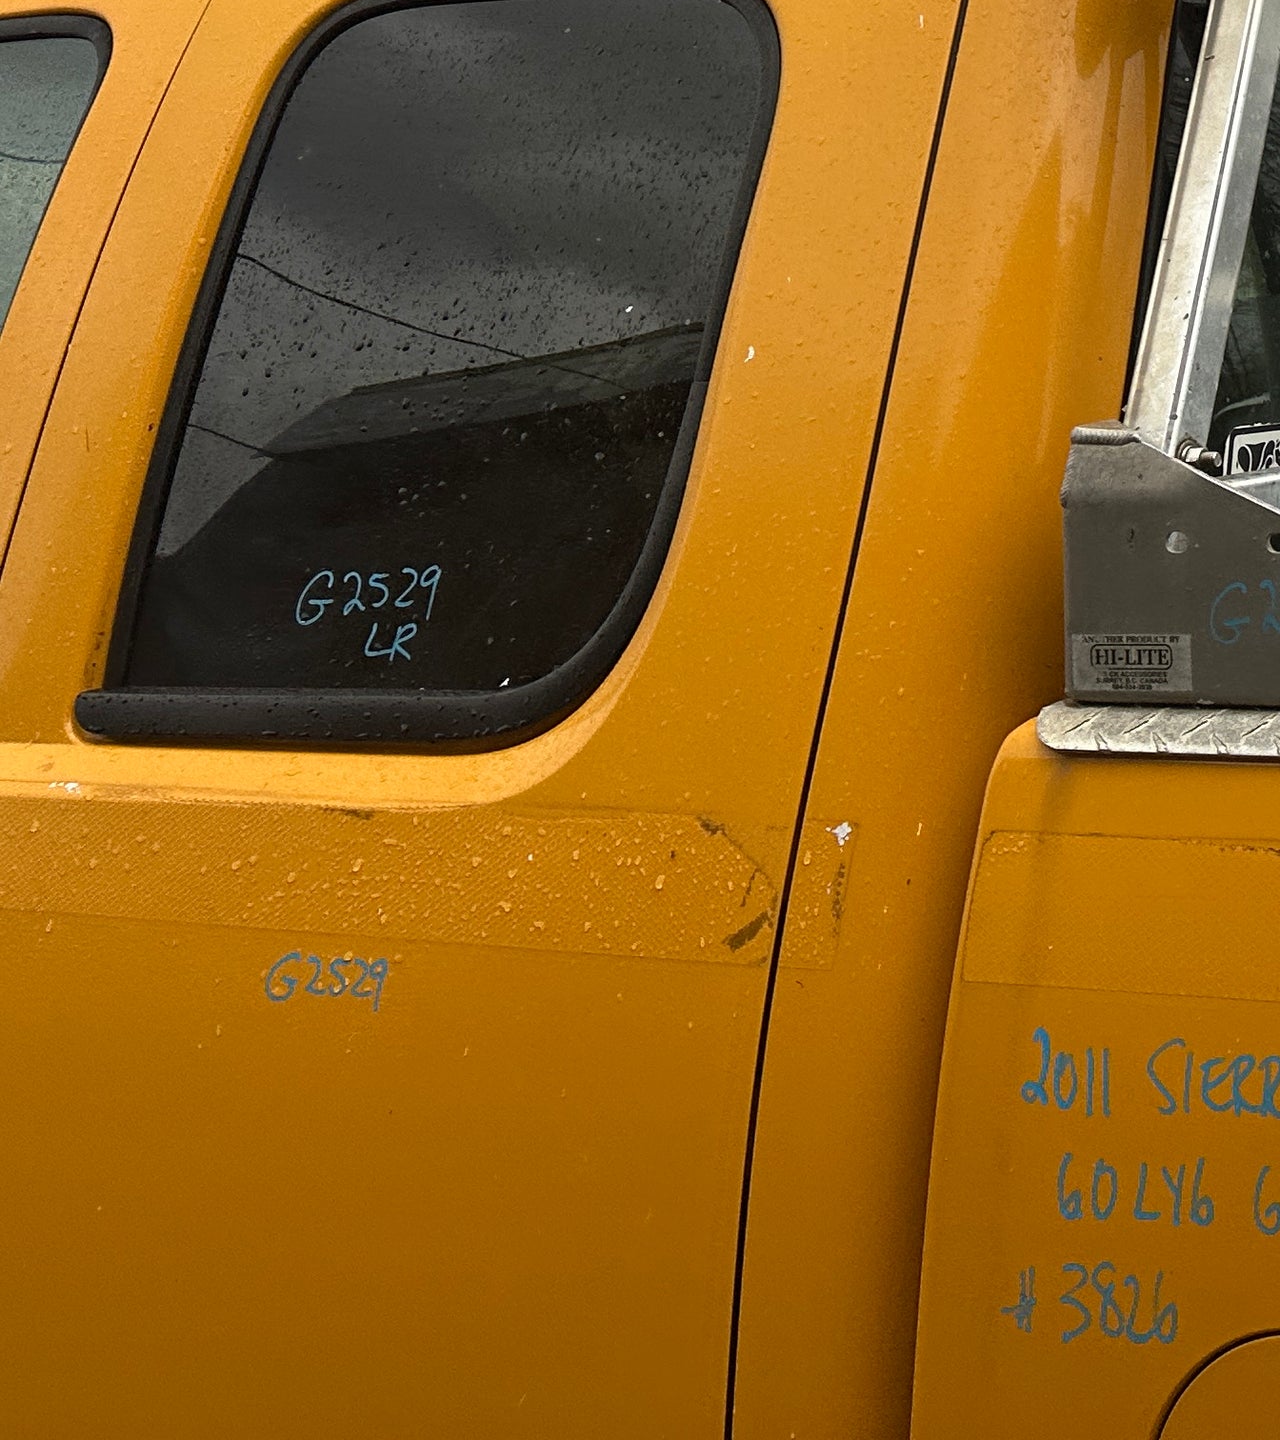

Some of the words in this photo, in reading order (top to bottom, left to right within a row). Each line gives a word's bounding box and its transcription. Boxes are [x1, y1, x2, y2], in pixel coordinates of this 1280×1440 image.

[295, 563, 442, 626] G2529
[364, 622, 417, 661] LR
[1094, 648, 1170, 666] HI-LITE
[265, 951, 389, 1013] G2529
[1021, 1026, 1110, 1117] 2011
